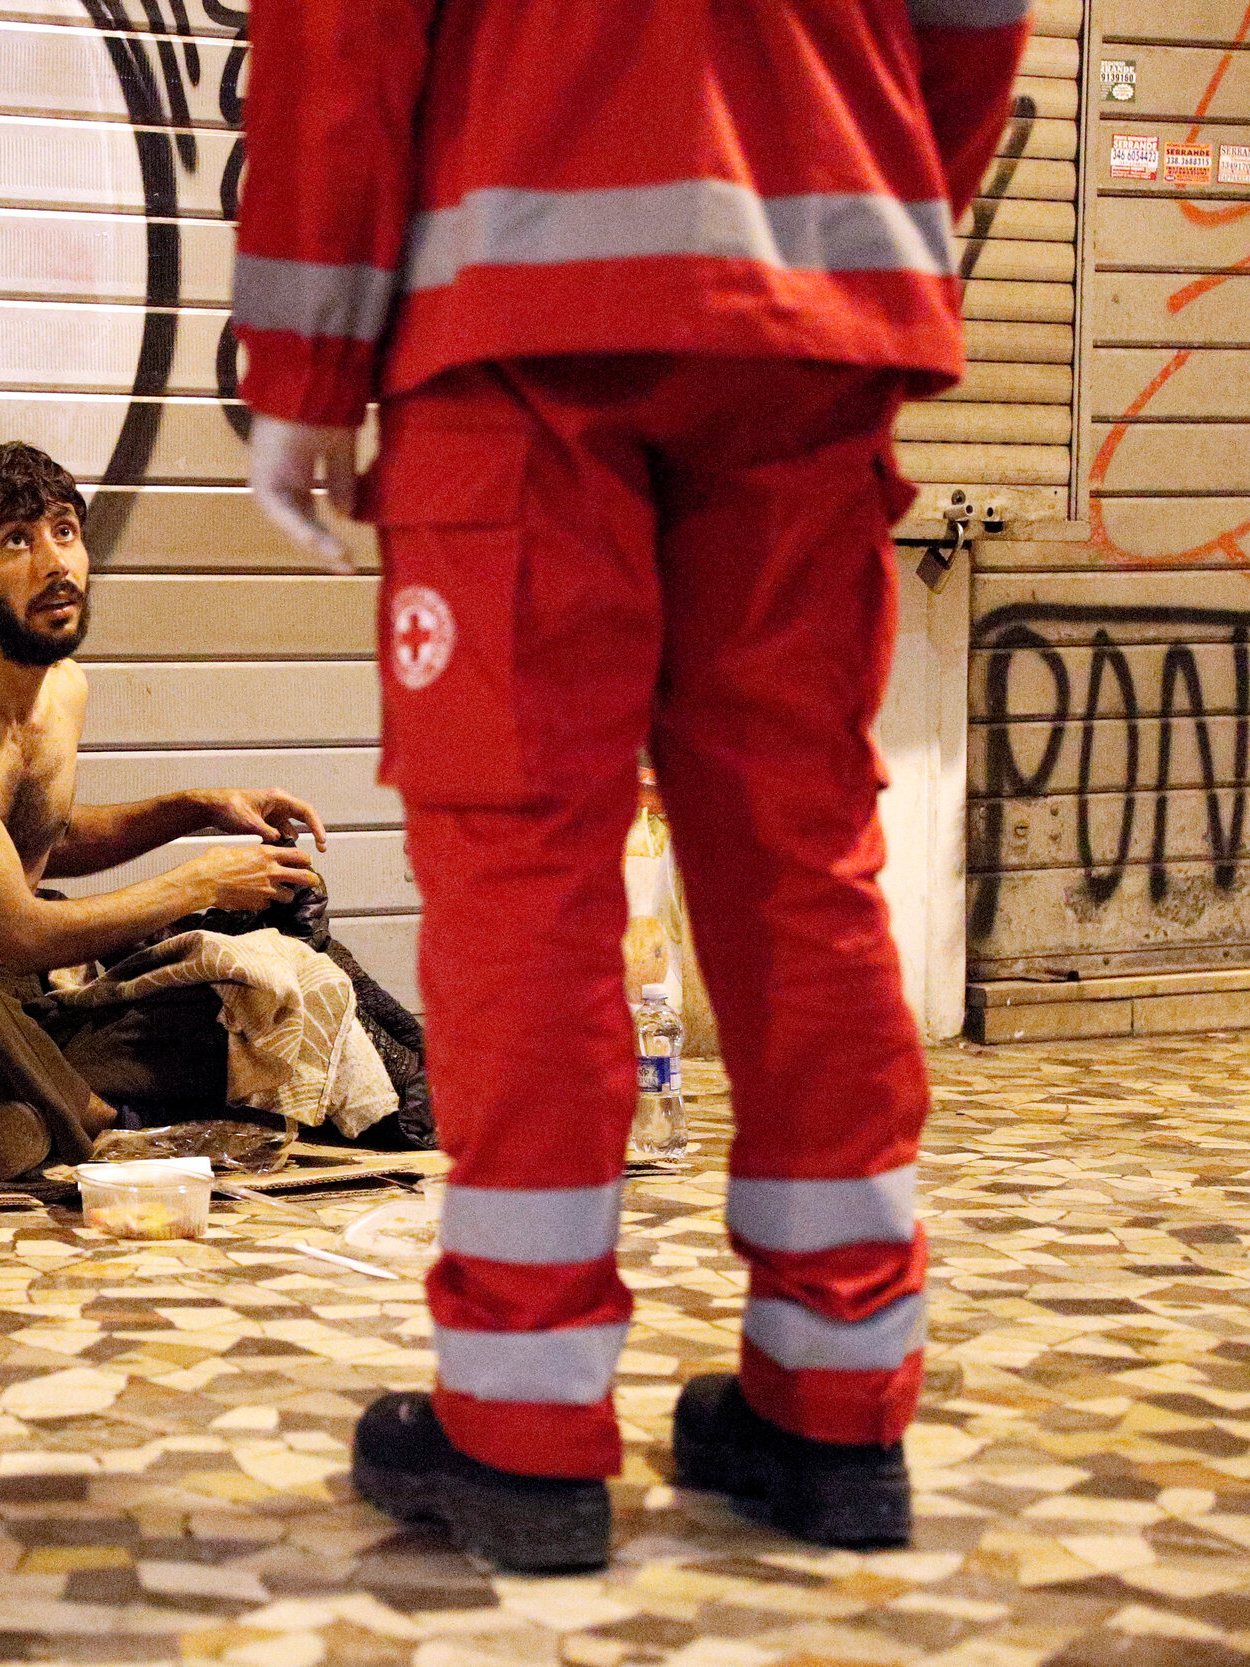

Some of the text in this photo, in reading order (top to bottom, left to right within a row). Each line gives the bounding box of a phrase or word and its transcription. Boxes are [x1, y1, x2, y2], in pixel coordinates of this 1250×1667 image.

[1113, 140, 1157, 151] SERRANDE
[1113, 148, 1125, 160] 346
[1166, 148, 1210, 157] SERRANDE
